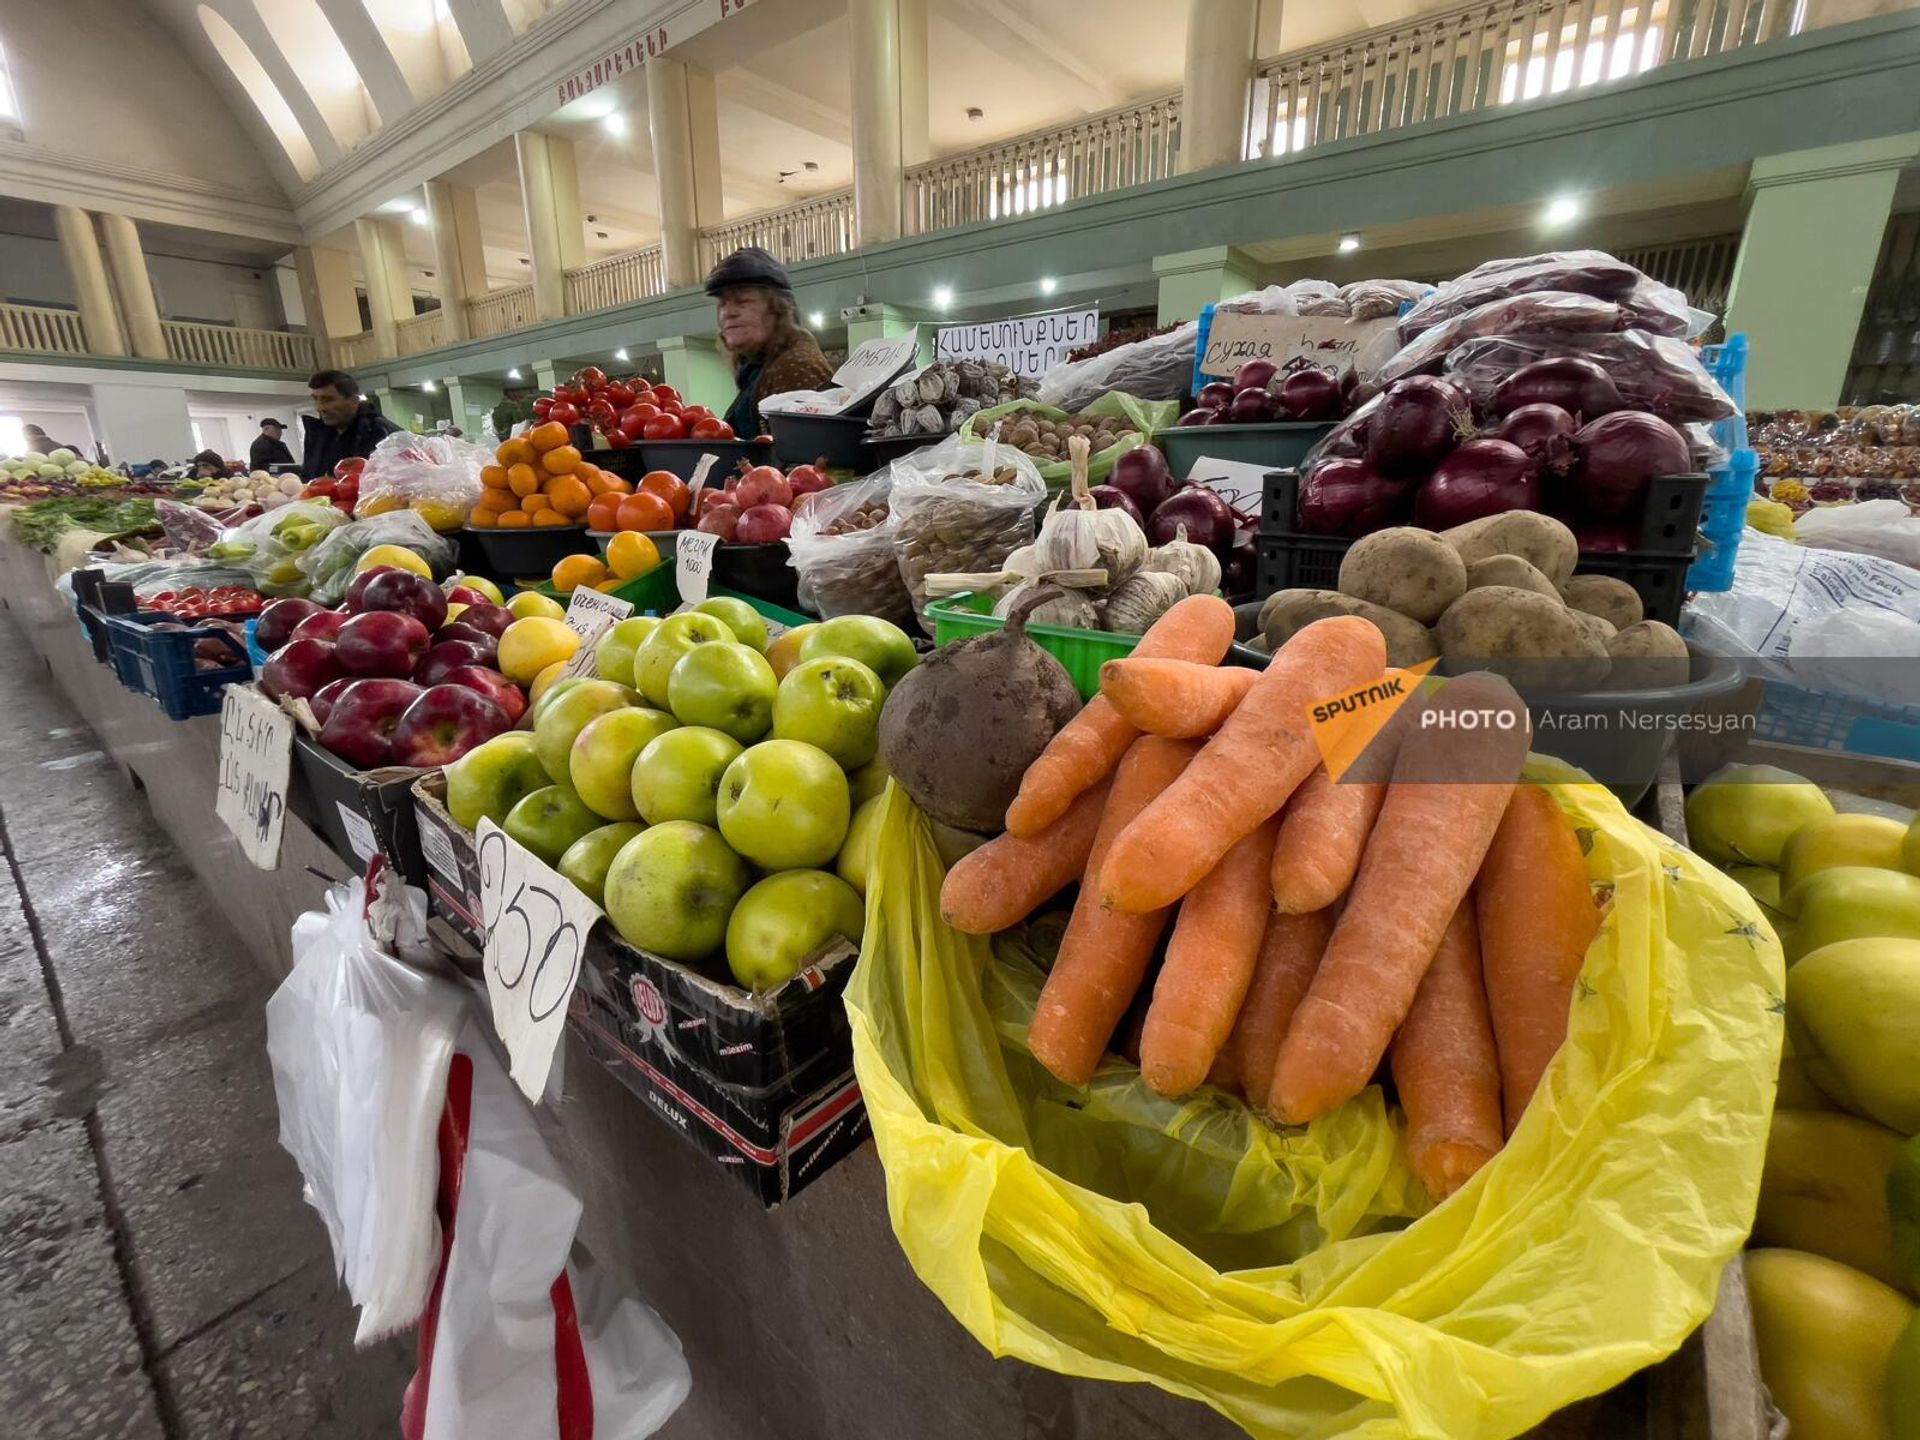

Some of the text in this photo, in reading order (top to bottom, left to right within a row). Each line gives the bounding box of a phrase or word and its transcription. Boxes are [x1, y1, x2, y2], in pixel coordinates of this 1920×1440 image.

[558, 27, 668, 107] ԲԱՆՋԱՐԵՂԵՆԻ
[1870, 574, 1904, 596] Facts
[479, 831, 580, 1023] 250
[648, 1089, 687, 1129] DELUX
